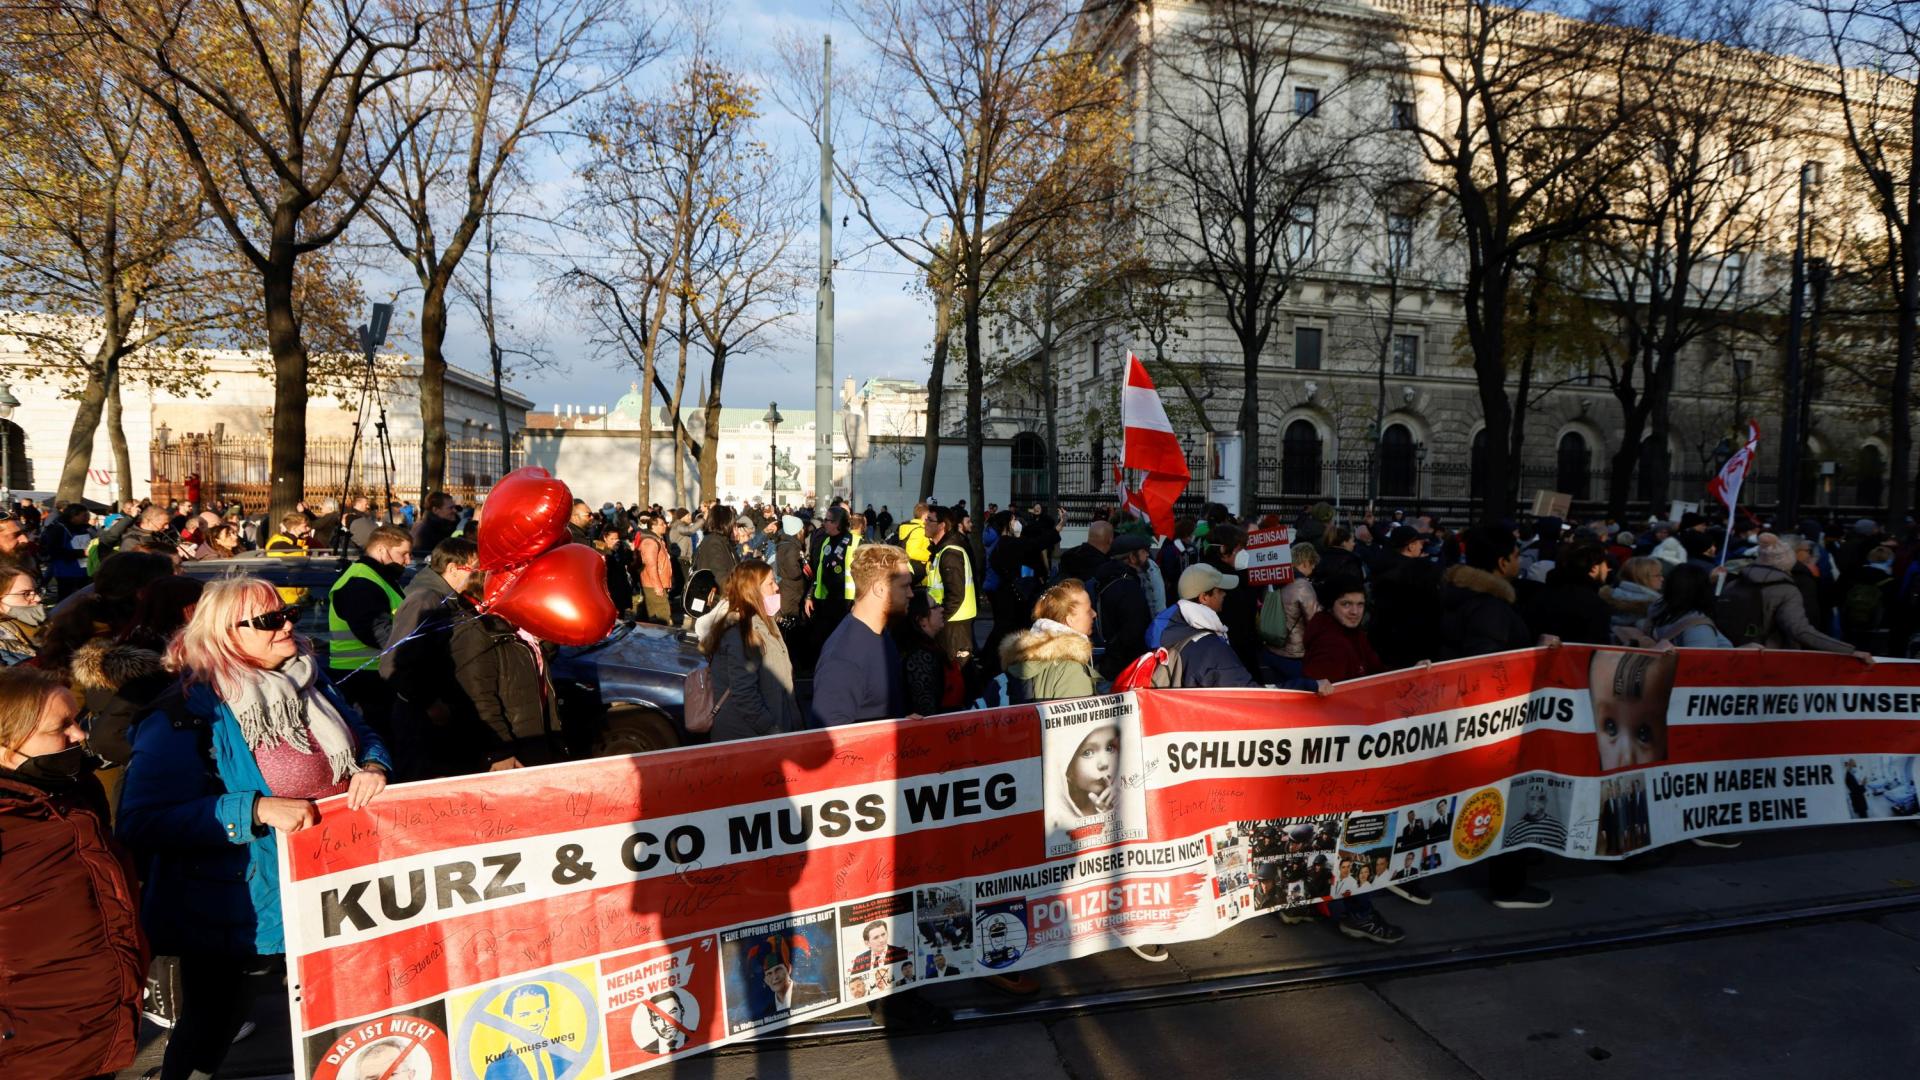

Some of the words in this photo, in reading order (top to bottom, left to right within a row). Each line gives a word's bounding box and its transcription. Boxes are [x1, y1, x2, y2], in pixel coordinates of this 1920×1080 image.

[1249, 566, 1291, 582] FREIHEIT
[1256, 553, 1266, 562] für
[1267, 551, 1278, 561] die
[1045, 717, 1062, 729] DEN
[1063, 712, 1088, 727] MUND
[1089, 704, 1133, 720] VERBIETEN!
[1050, 701, 1076, 715] LASST
[1686, 694, 1759, 716] FINGER
[1762, 693, 1799, 714] WEG
[1803, 692, 1837, 713] VON
[1167, 738, 1292, 773] SCHLUSS
[1301, 735, 1350, 764] MIT
[1358, 721, 1448, 761] CORONA
[1454, 697, 1575, 743] FASCHISMUS
[1652, 771, 1709, 802] LÜGEN
[1714, 767, 1777, 793] HABEN
[1783, 764, 1834, 787] SEHR
[1683, 801, 1743, 832] KURZE
[1750, 797, 1808, 821] BEINE
[321, 852, 527, 939] KURZ
[551, 843, 597, 886] &
[620, 824, 707, 873] CO
[728, 793, 887, 855] MUSS
[903, 773, 1017, 824] WEG
[975, 863, 1076, 898] KRIMINALISIERT
[1079, 852, 1125, 876] UNSERE
[1128, 846, 1175, 866] POLIZEI
[1179, 838, 1205, 859] NICHT
[1032, 881, 1171, 929] POLIZISTEN
[740, 924, 769, 939] IMPFUNG
[769, 921, 786, 932] GEHT
[786, 915, 806, 929] NICHT
[1034, 928, 1065, 945] SIND
[1066, 920, 1094, 940] KEINE
[1094, 908, 1172, 928] VERBRECHER!
[606, 957, 680, 991] NEHAMMER
[608, 986, 645, 1009] MUSS
[649, 973, 681, 995] WEG!
[326, 1036, 357, 1066] DAS
[358, 1022, 385, 1042] IST
[389, 1018, 436, 1042] NICHT
[485, 1050, 515, 1066] Kurz
[515, 1041, 549, 1057] muss
[550, 1030, 576, 1046] weg
